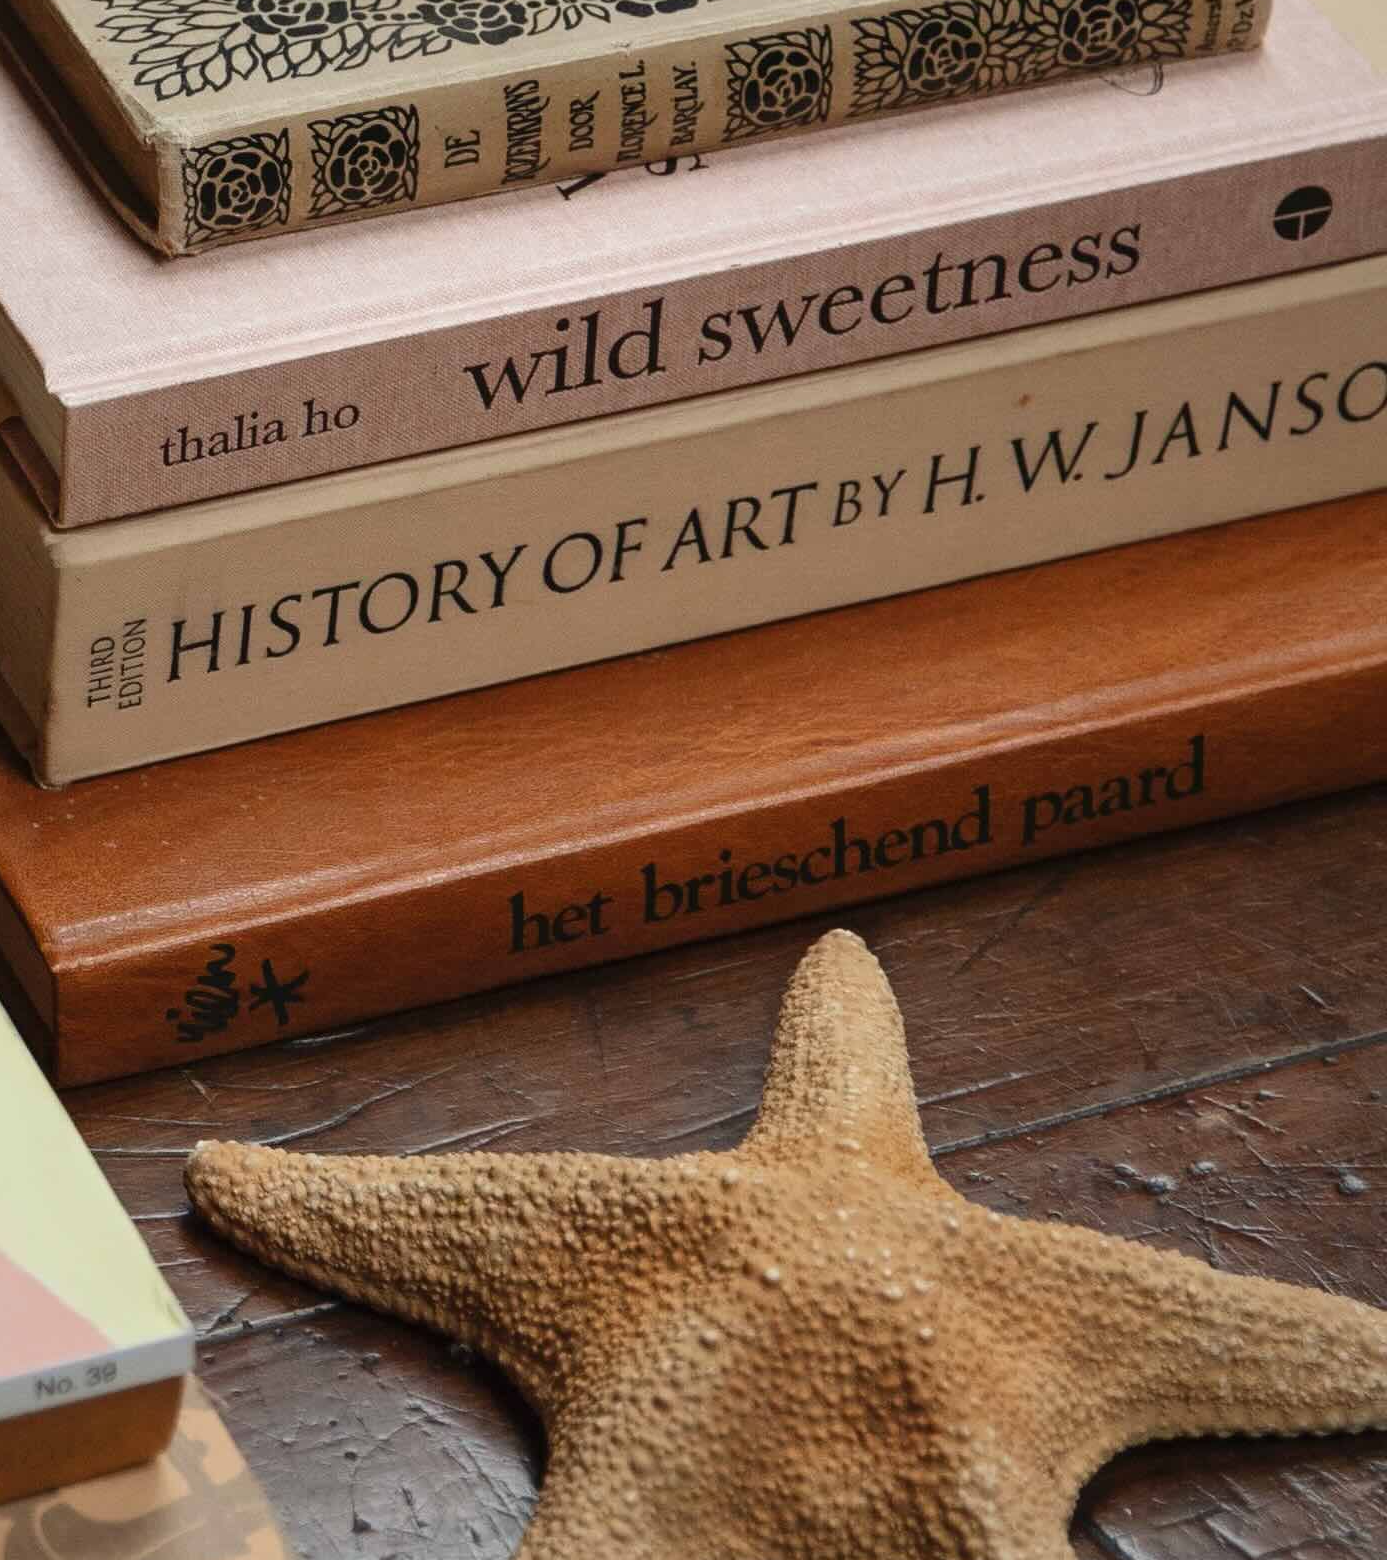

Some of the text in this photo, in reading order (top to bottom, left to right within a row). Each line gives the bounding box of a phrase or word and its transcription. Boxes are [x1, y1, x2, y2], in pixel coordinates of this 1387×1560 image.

[501, 79, 551, 185] ROZENKRANS
[568, 90, 600, 152] DOOR
[616, 83, 658, 163] FLORENCE
[670, 60, 705, 147] BARCLAY.
[444, 128, 481, 168] DE
[462, 221, 1144, 413] wild sweetness
[159, 395, 361, 470] thalia ho
[166, 543, 527, 683] HISTORY
[542, 517, 649, 594] OF
[661, 480, 818, 572] ART
[832, 469, 907, 528] BY
[922, 445, 985, 514] H.
[87, 636, 115, 708] THIRD
[118, 619, 146, 710] EDITION
[507, 734, 1206, 955] het brieschend paard
